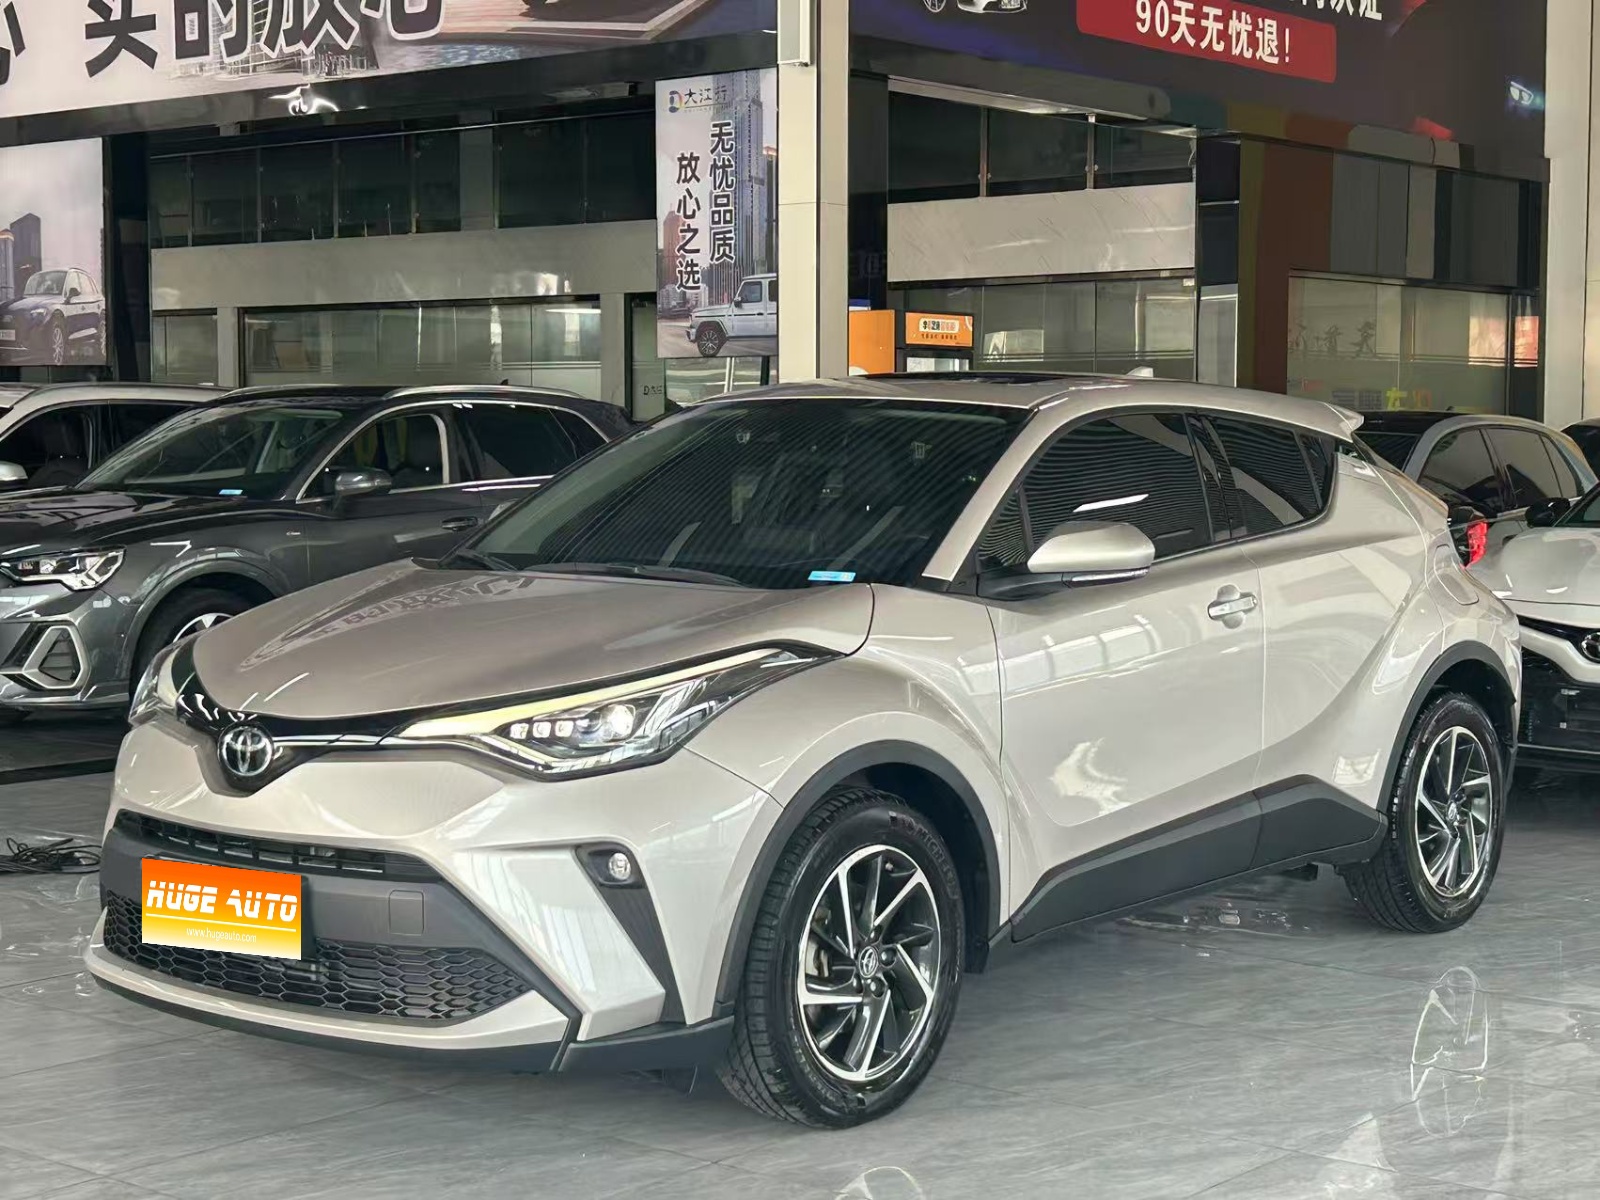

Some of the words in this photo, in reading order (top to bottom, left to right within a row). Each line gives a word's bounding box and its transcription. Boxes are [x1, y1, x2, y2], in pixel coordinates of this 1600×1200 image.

[676, 151, 701, 292] 放心之选
[709, 121, 735, 263] 无忧品质
